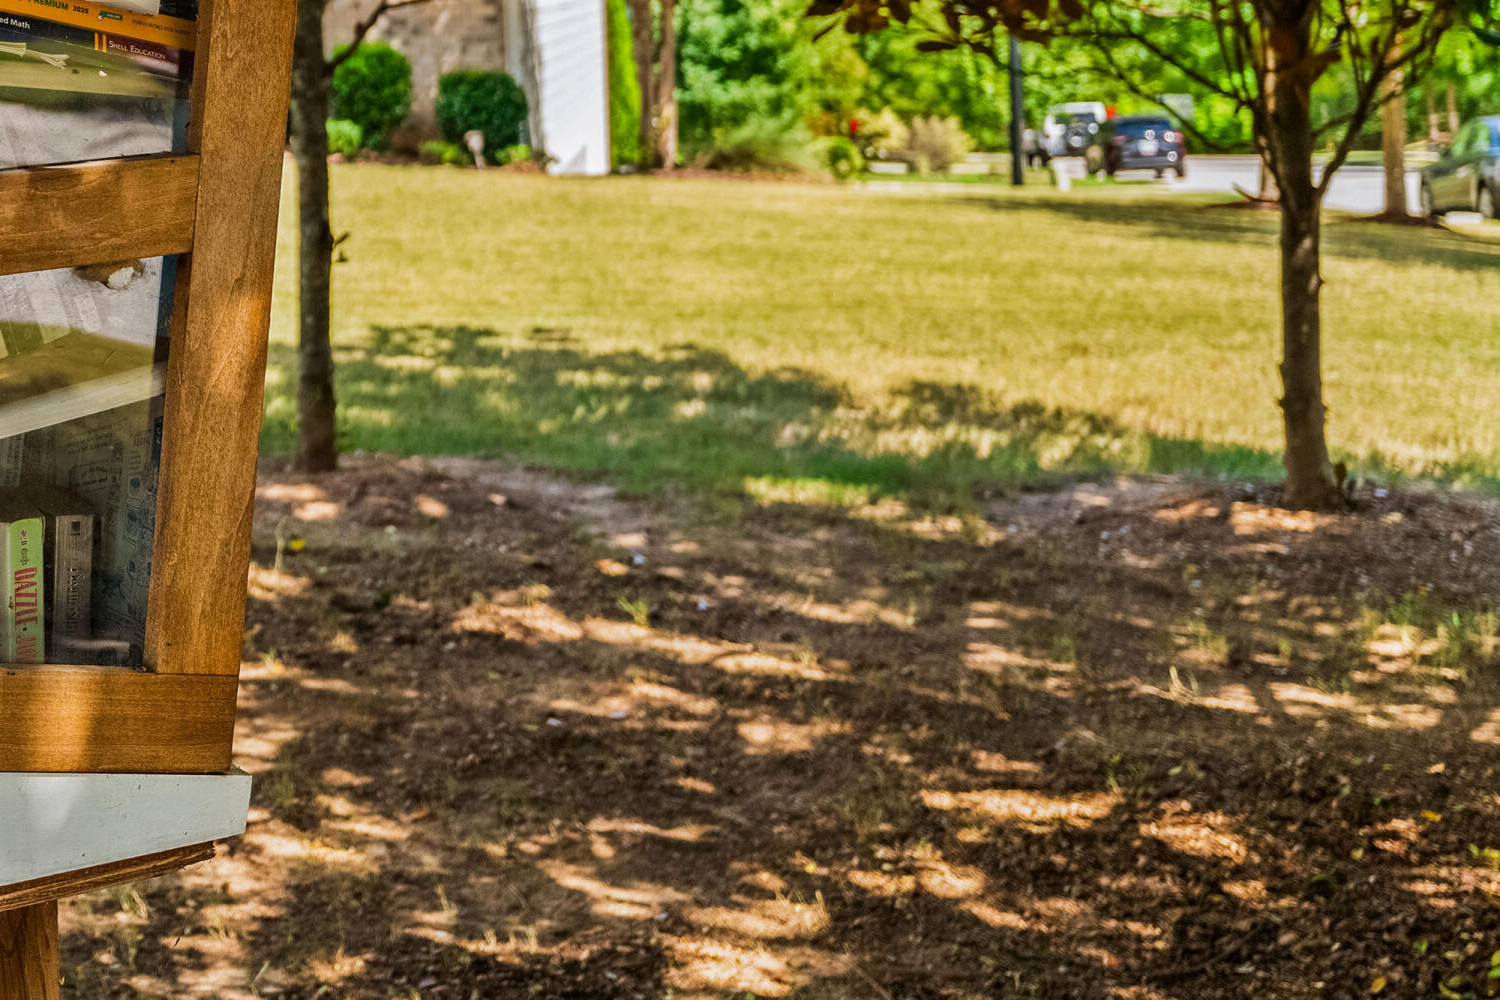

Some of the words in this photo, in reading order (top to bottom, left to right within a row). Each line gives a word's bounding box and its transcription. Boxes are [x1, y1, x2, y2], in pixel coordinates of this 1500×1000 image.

[72, 5, 90, 15] 2025
[10, 18, 31, 30] Math
[109, 40, 128, 52] SHELL
[130, 45, 167, 61] EDUCATION
[14, 567, 38, 628] DAZZLE
